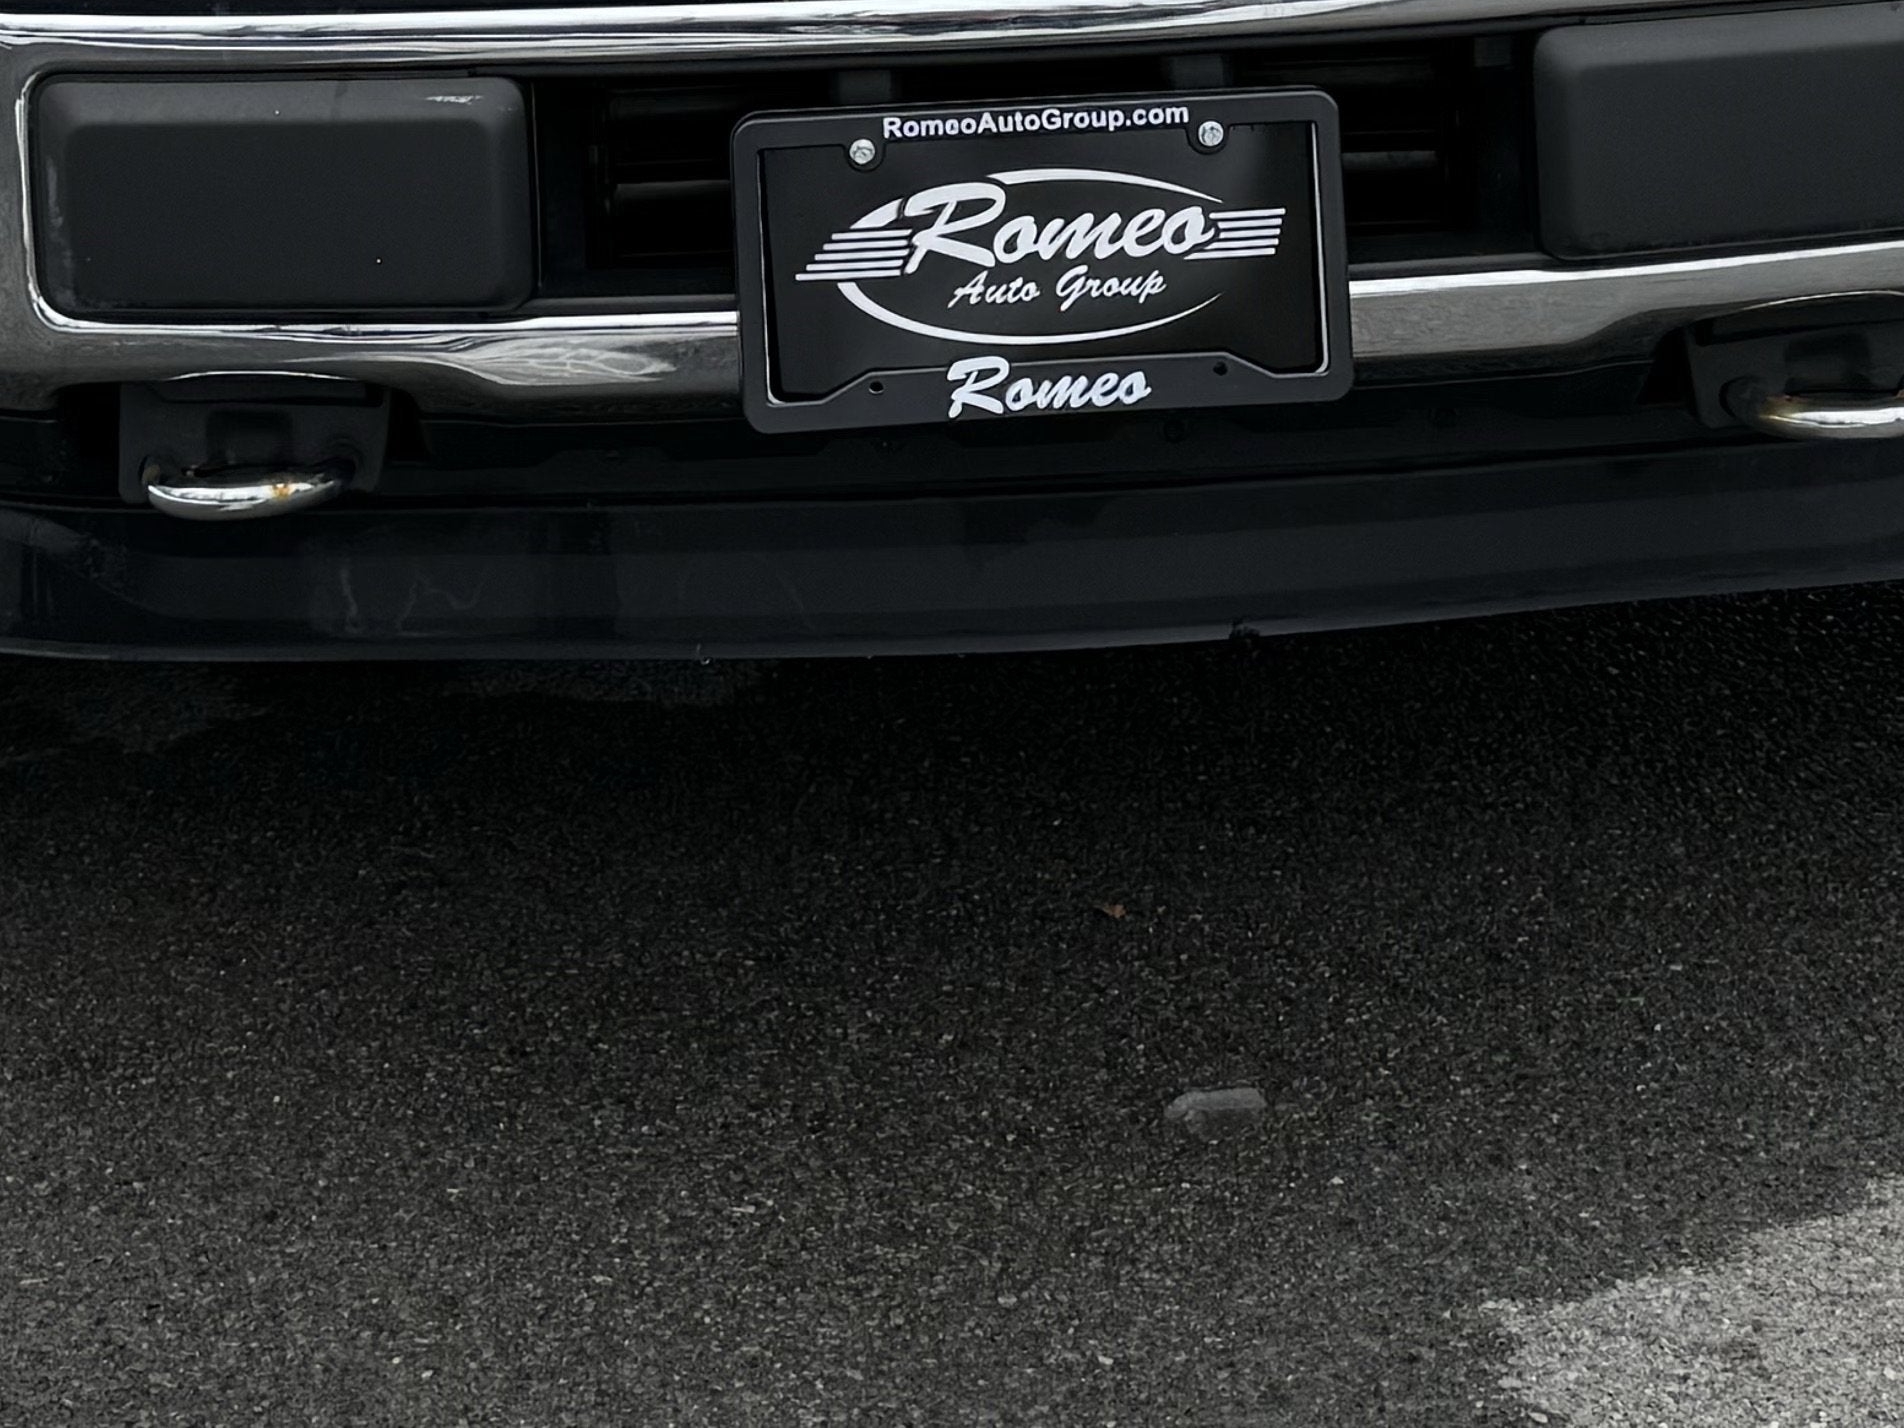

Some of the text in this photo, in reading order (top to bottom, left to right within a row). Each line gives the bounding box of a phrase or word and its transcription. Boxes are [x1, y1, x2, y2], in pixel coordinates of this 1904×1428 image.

[882, 105, 1189, 140] RomeoAutoGroup.com
[903, 181, 1215, 274] Romeo
[947, 265, 1167, 312] Auto Group
[945, 355, 1152, 419] Romeo
